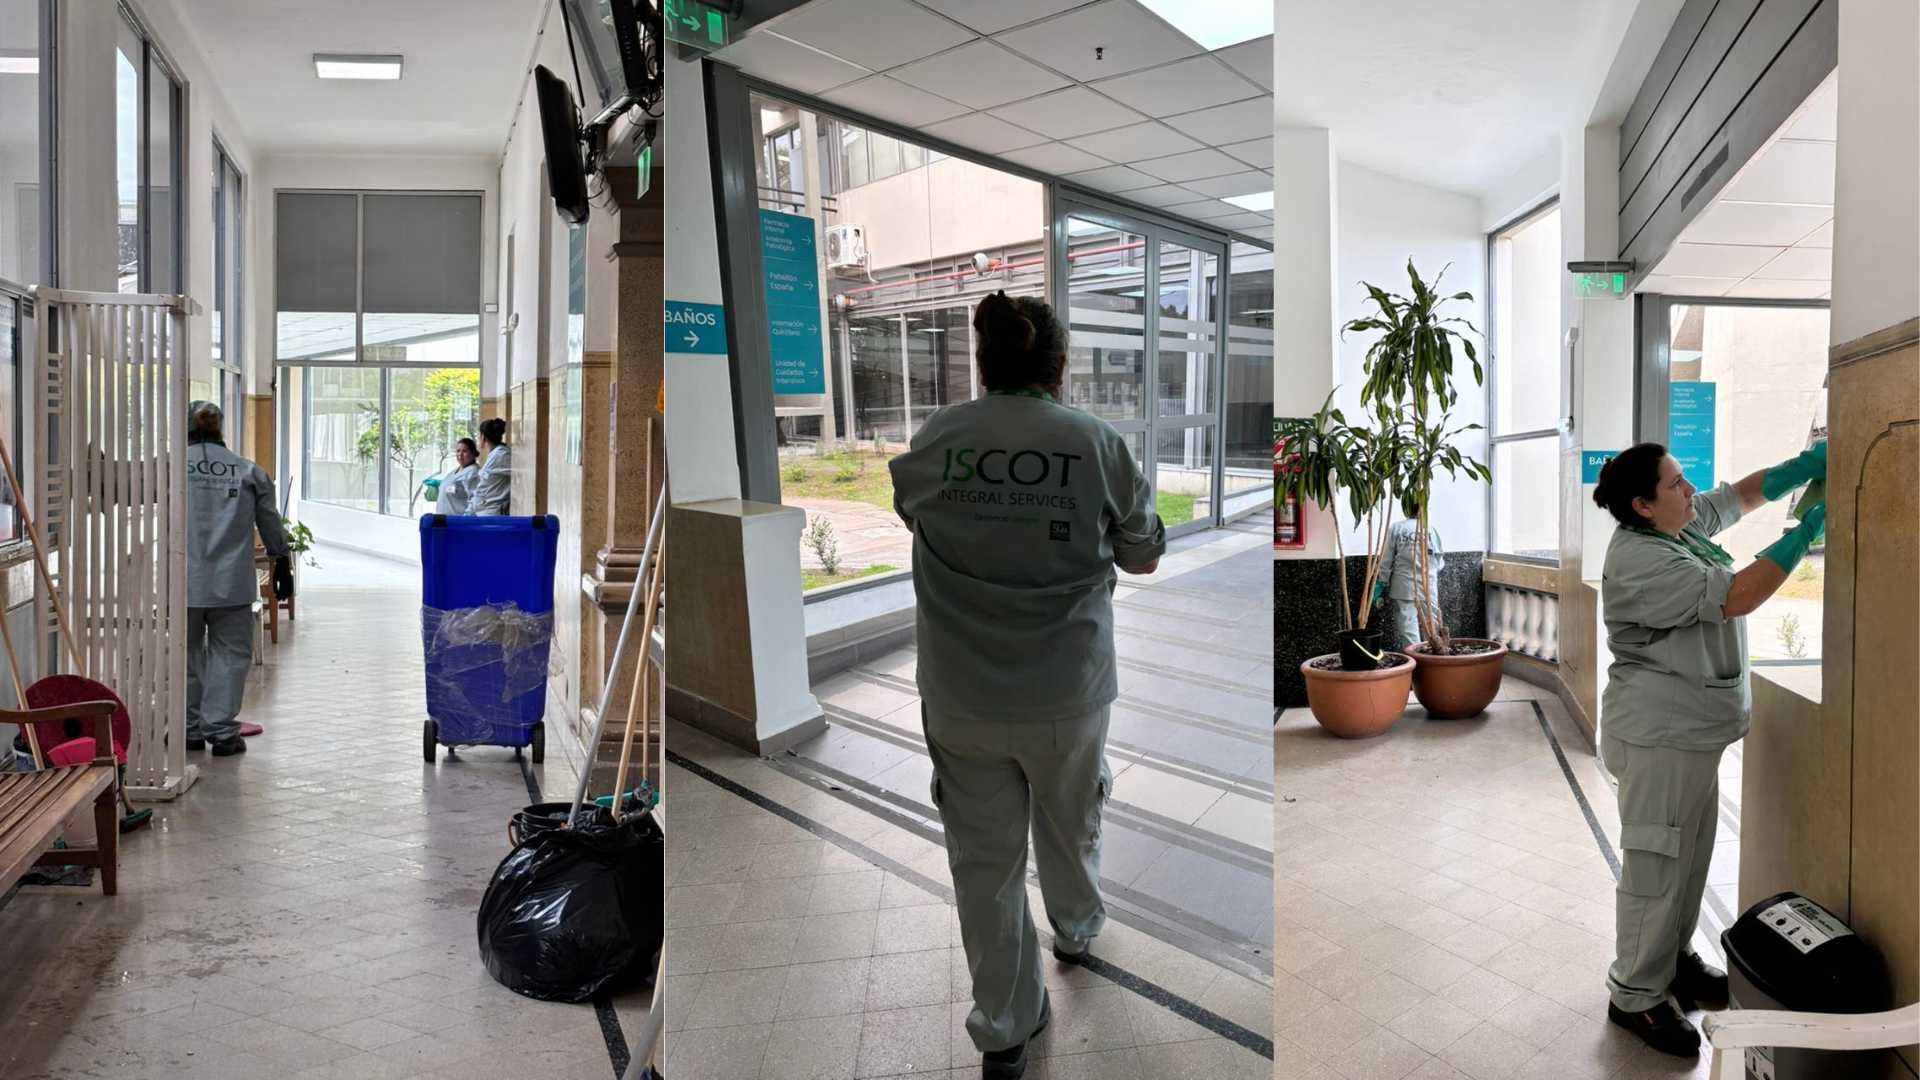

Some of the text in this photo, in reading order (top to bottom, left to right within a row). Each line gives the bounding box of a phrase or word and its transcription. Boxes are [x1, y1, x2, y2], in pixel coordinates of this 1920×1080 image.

[664, 307, 716, 326] BAÑOS
[187, 460, 238, 477] SCOT
[943, 448, 1082, 488] ISCOT
[937, 488, 1077, 510] INTEGRAL SERVICES
